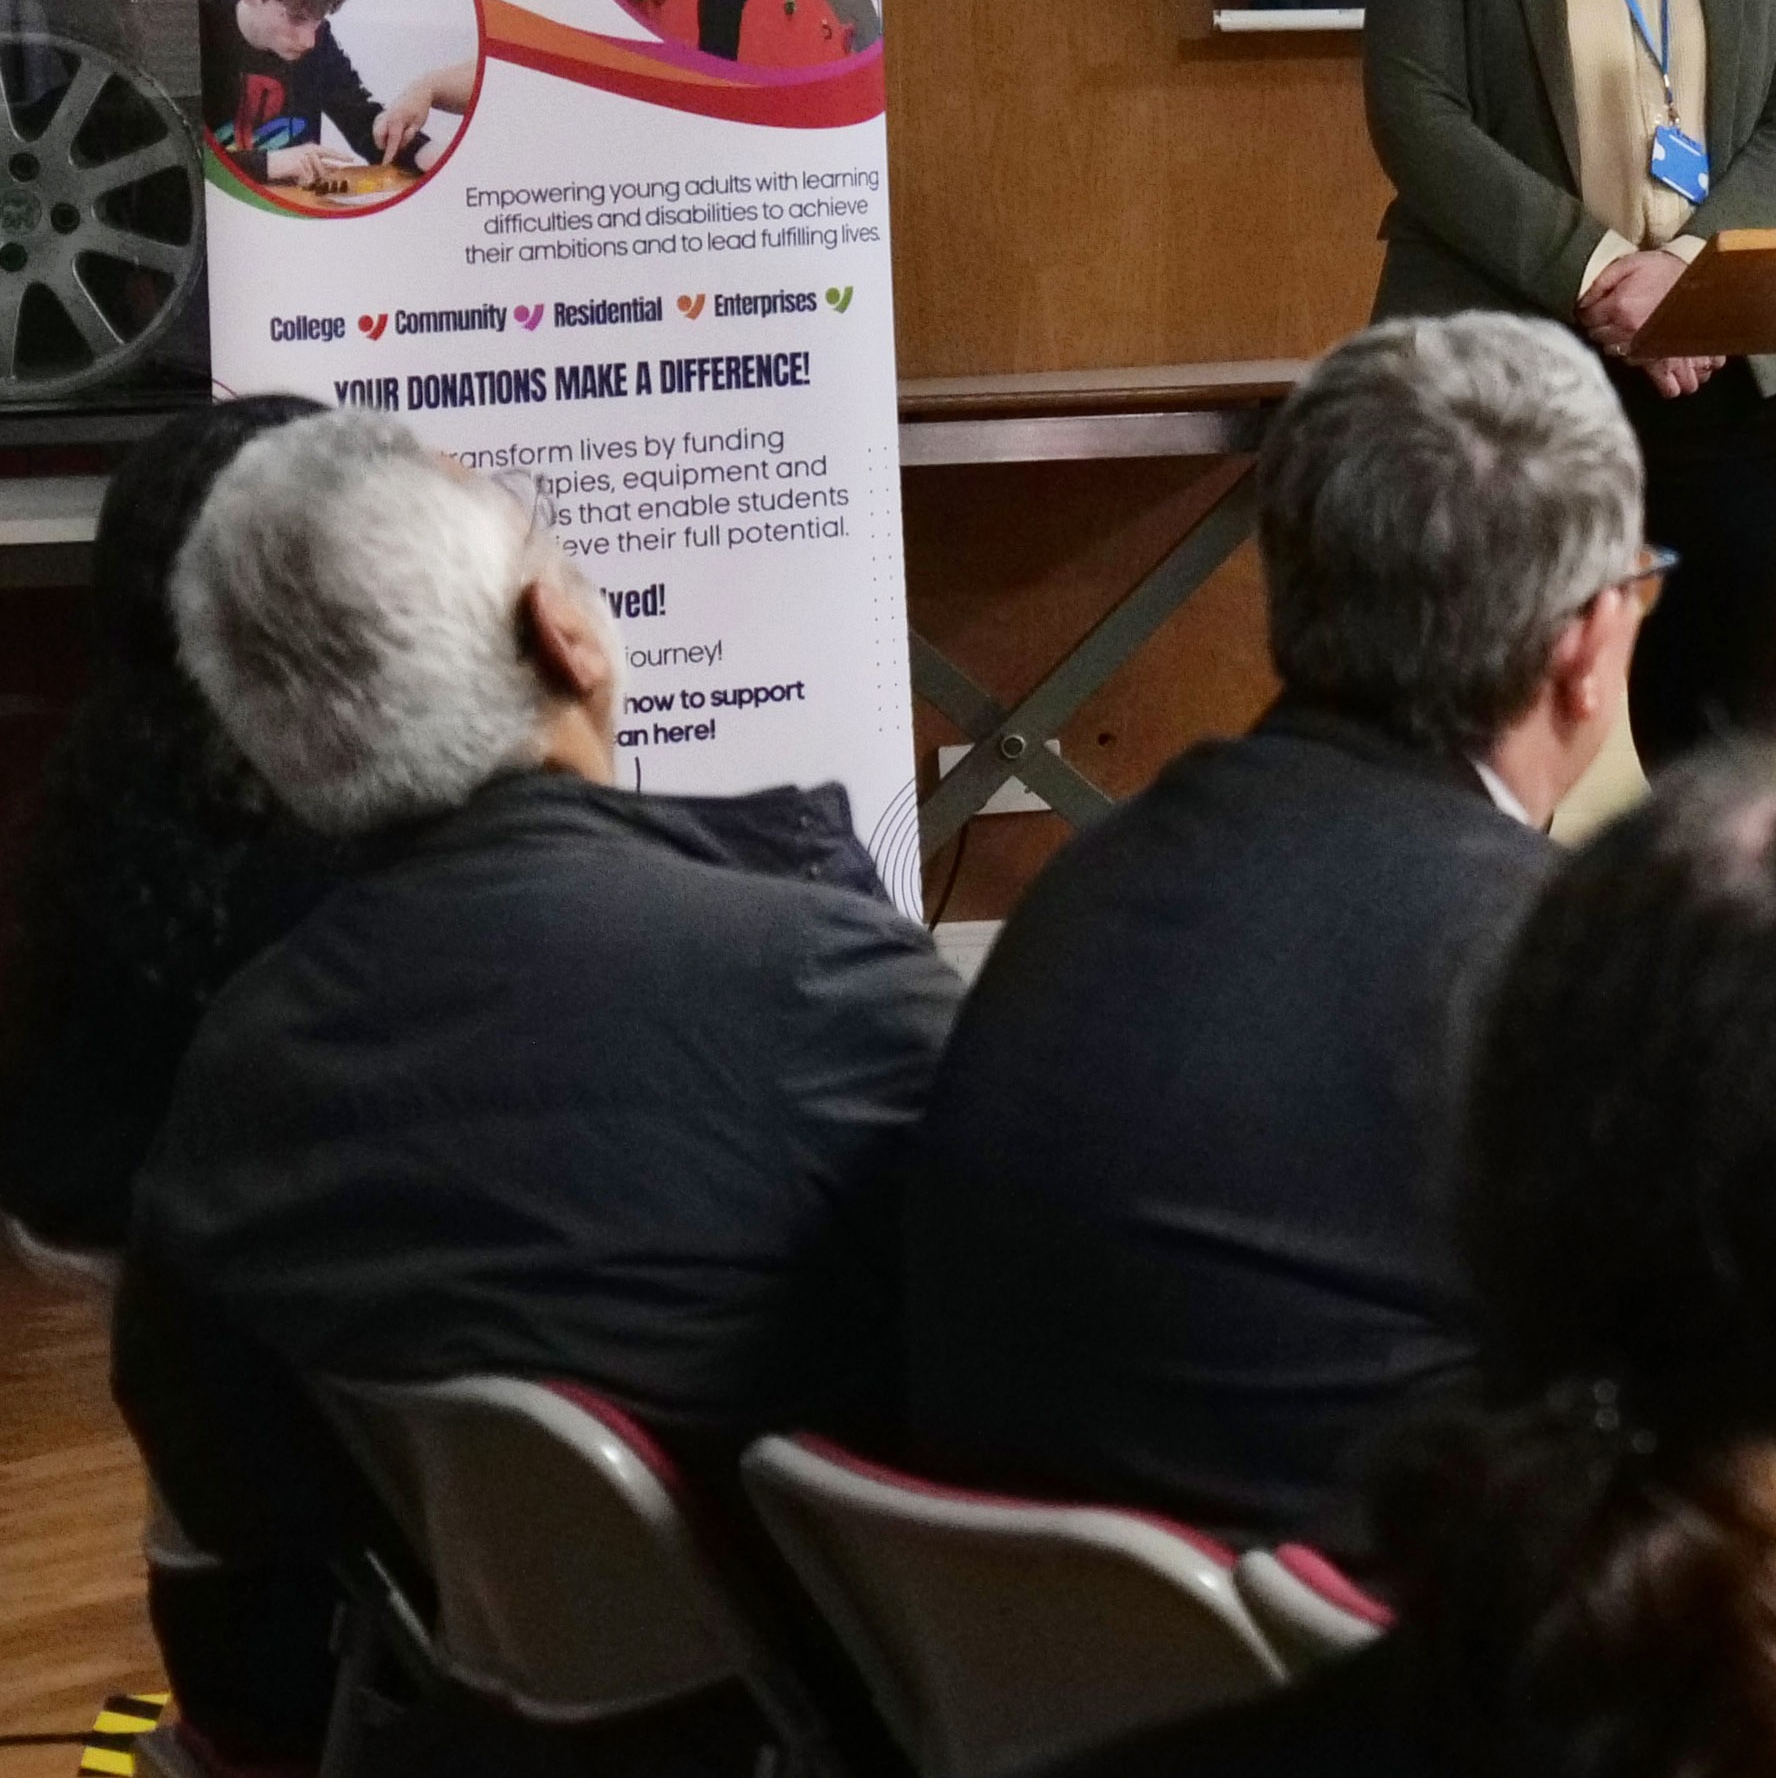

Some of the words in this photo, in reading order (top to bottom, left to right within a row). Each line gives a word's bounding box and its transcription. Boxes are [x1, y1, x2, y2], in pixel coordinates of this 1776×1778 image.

[465, 181, 606, 210] Empowering
[608, 180, 681, 205] young
[684, 174, 752, 196] adults
[755, 171, 798, 193] with
[802, 170, 879, 191] learning
[483, 210, 594, 235] difficulties
[596, 206, 642, 229] and
[646, 203, 759, 227] disabilities
[762, 202, 784, 220] to
[788, 198, 868, 219] achieve
[464, 244, 515, 265] their
[518, 237, 629, 262] ambitions
[632, 234, 677, 256] and
[681, 234, 703, 253] to
[707, 229, 756, 251] lead
[761, 226, 838, 250] fulfilling
[270, 315, 346, 342] College
[395, 303, 508, 335] Community
[553, 296, 663, 327] Residential
[714, 289, 818, 319] Enterprises
[334, 377, 399, 412] YOUR
[407, 367, 547, 411] DONATIONS
[554, 362, 628, 401] MAKE
[635, 361, 653, 396] A
[659, 351, 811, 395] DIFFERENCE!
[441, 443, 573, 469] ansform
[580, 437, 638, 461] lives
[644, 435, 676, 460] by
[682, 428, 784, 454] funding
[622, 460, 770, 492] equipment
[775, 454, 827, 479] and
[578, 501, 632, 525] that
[637, 493, 731, 520] enable
[737, 486, 849, 514] students
[617, 527, 677, 553] their
[683, 524, 720, 548] full
[727, 515, 849, 550] potential.
[679, 689, 706, 710] to
[710, 680, 806, 710] support
[653, 718, 716, 745] here!
